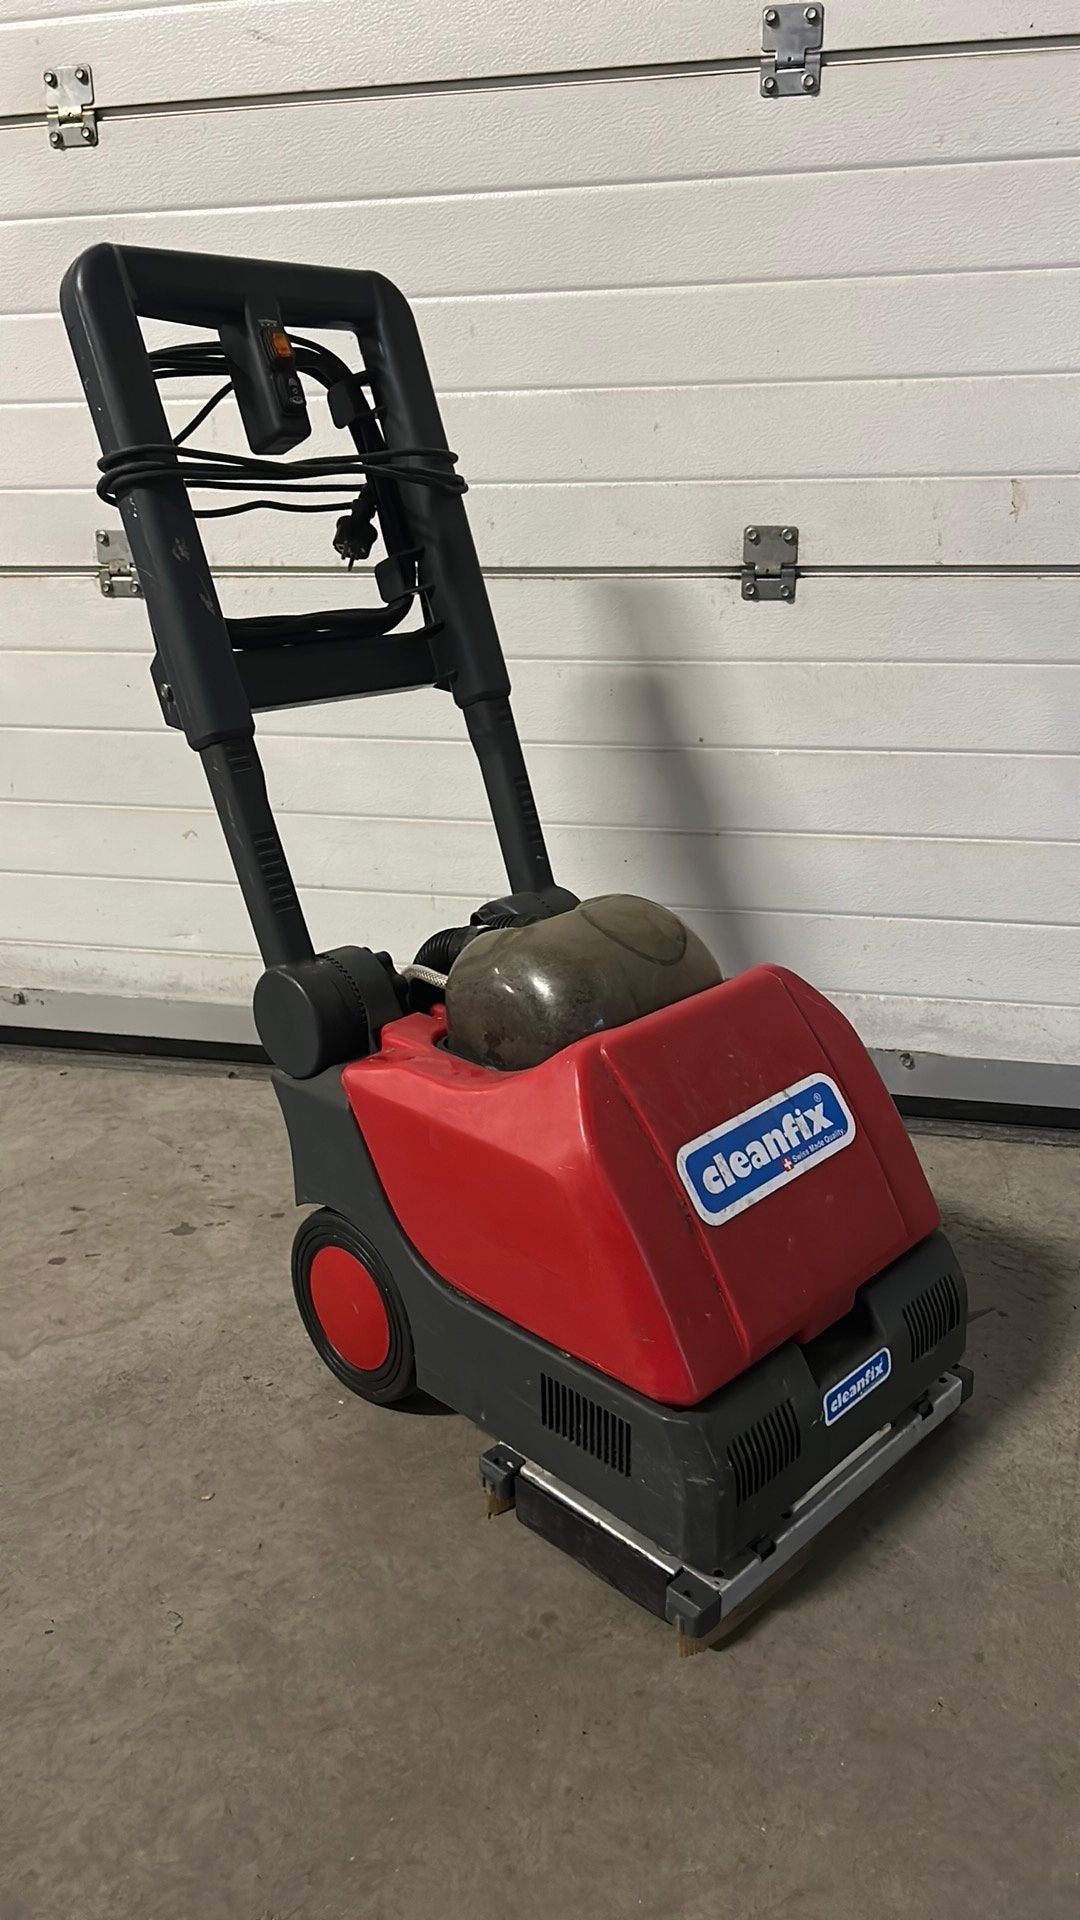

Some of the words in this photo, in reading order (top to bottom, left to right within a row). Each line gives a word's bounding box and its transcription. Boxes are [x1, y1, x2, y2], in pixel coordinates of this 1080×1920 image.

[702, 1101, 834, 1194] cleanfix
[791, 1149, 810, 1163] Swiss
[808, 1140, 825, 1153] Made
[830, 1361, 884, 1413] cleanfix
